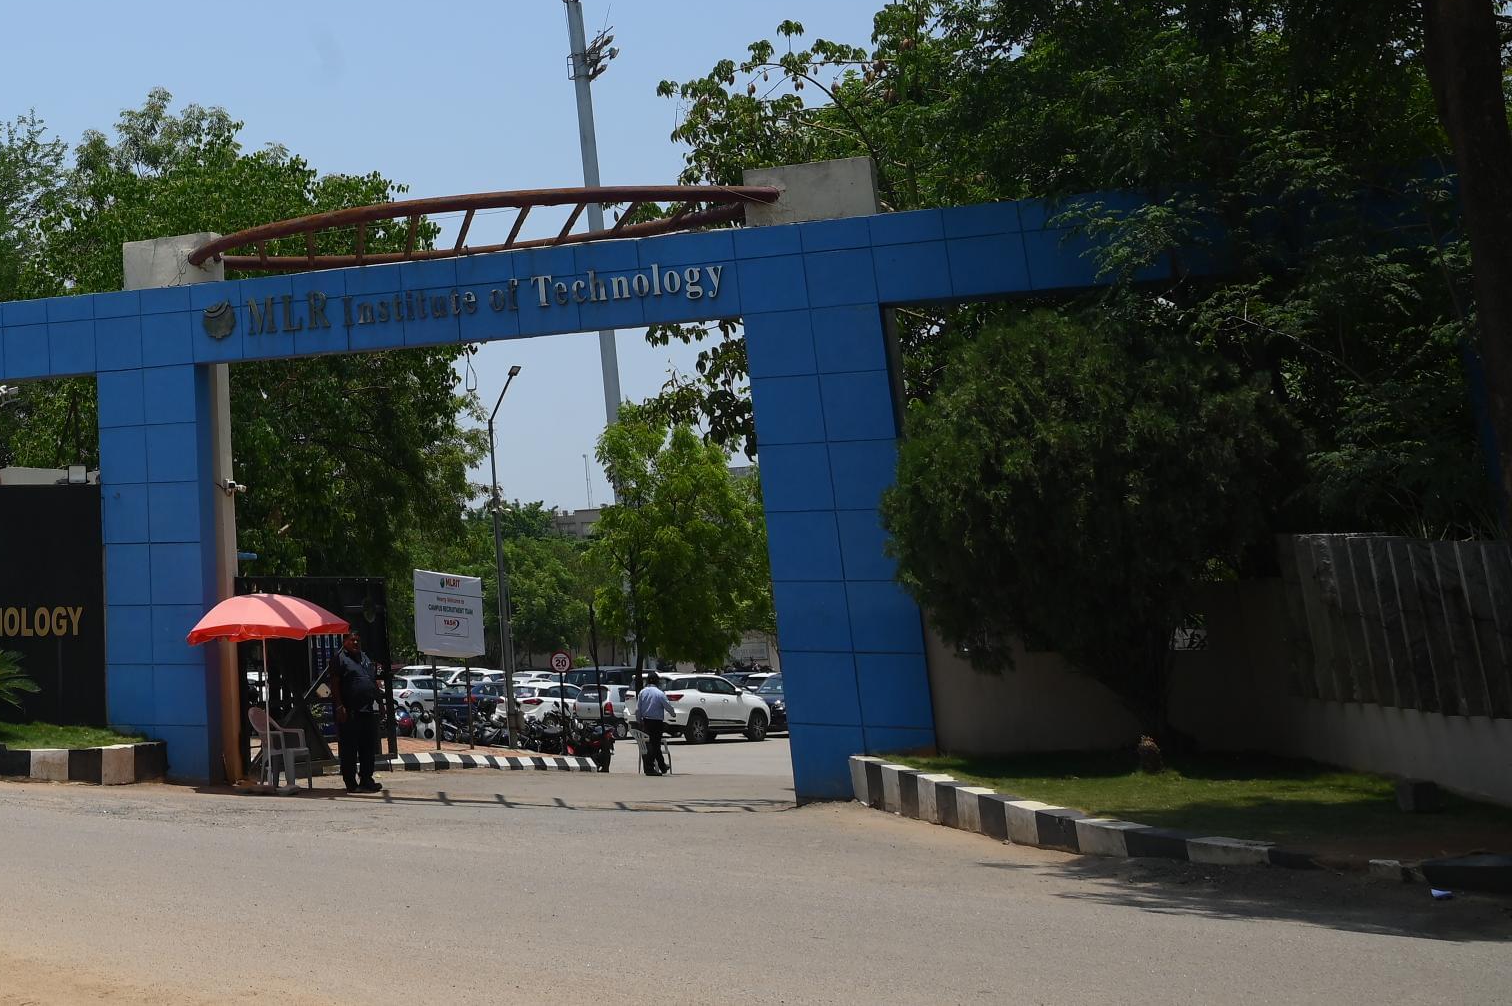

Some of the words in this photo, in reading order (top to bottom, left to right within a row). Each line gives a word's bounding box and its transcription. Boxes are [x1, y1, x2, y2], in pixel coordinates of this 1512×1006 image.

[247, 290, 331, 335] MLR
[343, 286, 476, 326] Institute
[488, 278, 519, 312] of
[530, 263, 724, 308] Technology
[556, 659, 566, 667] 20
